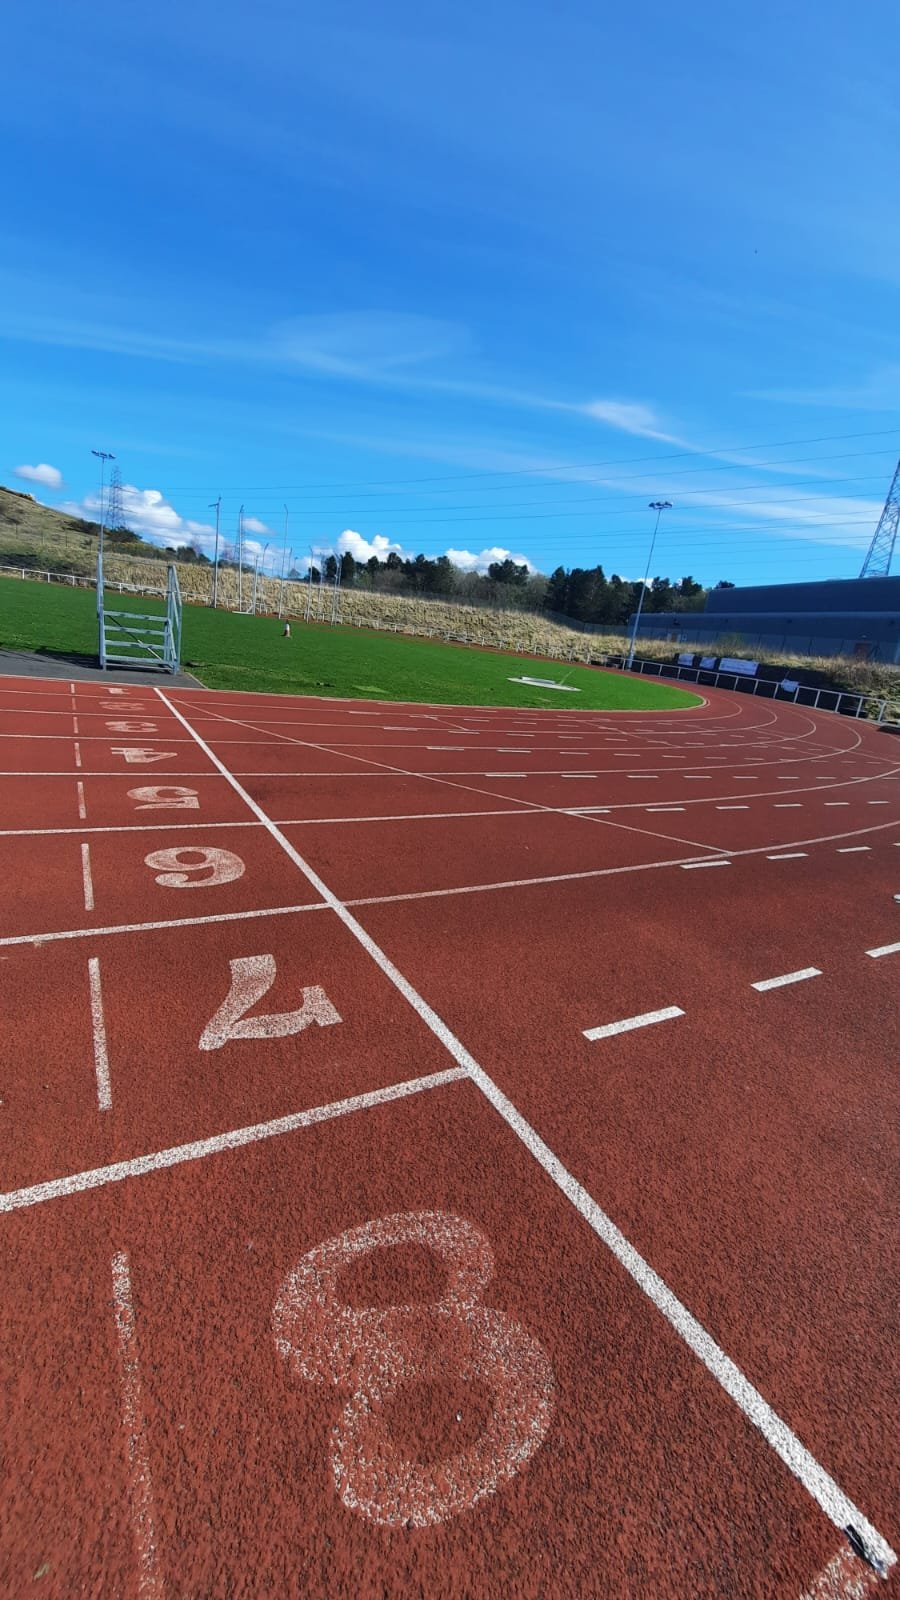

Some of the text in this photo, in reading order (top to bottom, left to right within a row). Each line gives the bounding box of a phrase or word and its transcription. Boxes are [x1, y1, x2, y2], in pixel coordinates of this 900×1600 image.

[104, 721, 159, 733] 3
[110, 747, 178, 764] 4
[126, 785, 200, 811] 5
[143, 846, 246, 889] 6
[198, 954, 343, 1051] 7
[272, 1208, 556, 1529] 8
